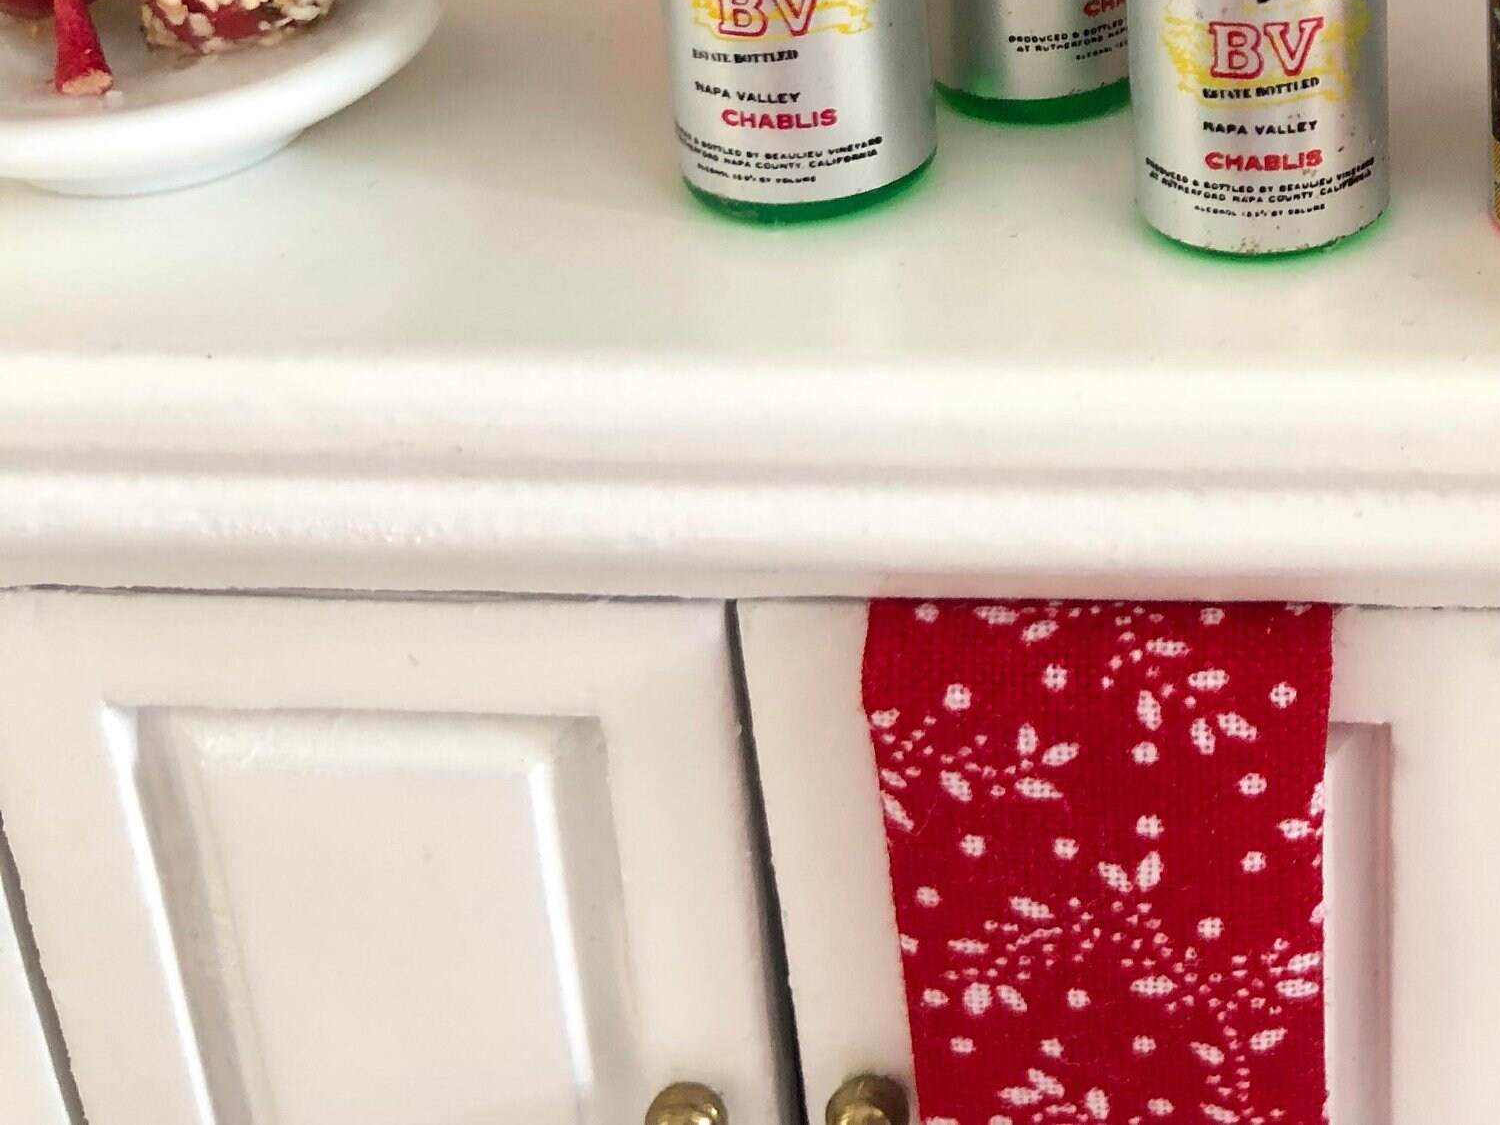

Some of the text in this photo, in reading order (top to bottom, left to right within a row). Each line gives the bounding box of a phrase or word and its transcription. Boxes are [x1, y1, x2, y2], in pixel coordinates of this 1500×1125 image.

[1008, 34, 1068, 43] PRODUCED
[1208, 16, 1324, 80] BV
[734, 49, 799, 63] BOTTLED
[694, 80, 801, 104] NAPA VALLEY
[1202, 77, 1320, 99] ESTATE BOTTLED
[721, 108, 838, 130] CHABLIS
[1203, 119, 1318, 136] NAPA VALLEY
[701, 140, 742, 157] BOTTLED
[746, 151, 760, 159] BY
[765, 150, 823, 161] BEAULIEU
[828, 135, 883, 156] VINEYARD
[723, 157, 751, 168] NAPA
[808, 148, 878, 169] CALIFORNIA
[1204, 149, 1323, 171] CHABLIS
[1161, 177, 1226, 202] RUTHERFORD
[1232, 195, 1263, 203] NAPA
[1203, 181, 1254, 193] BOTTLED
[1259, 185, 1274, 193] BY
[1279, 177, 1333, 193] BEAULIEU
